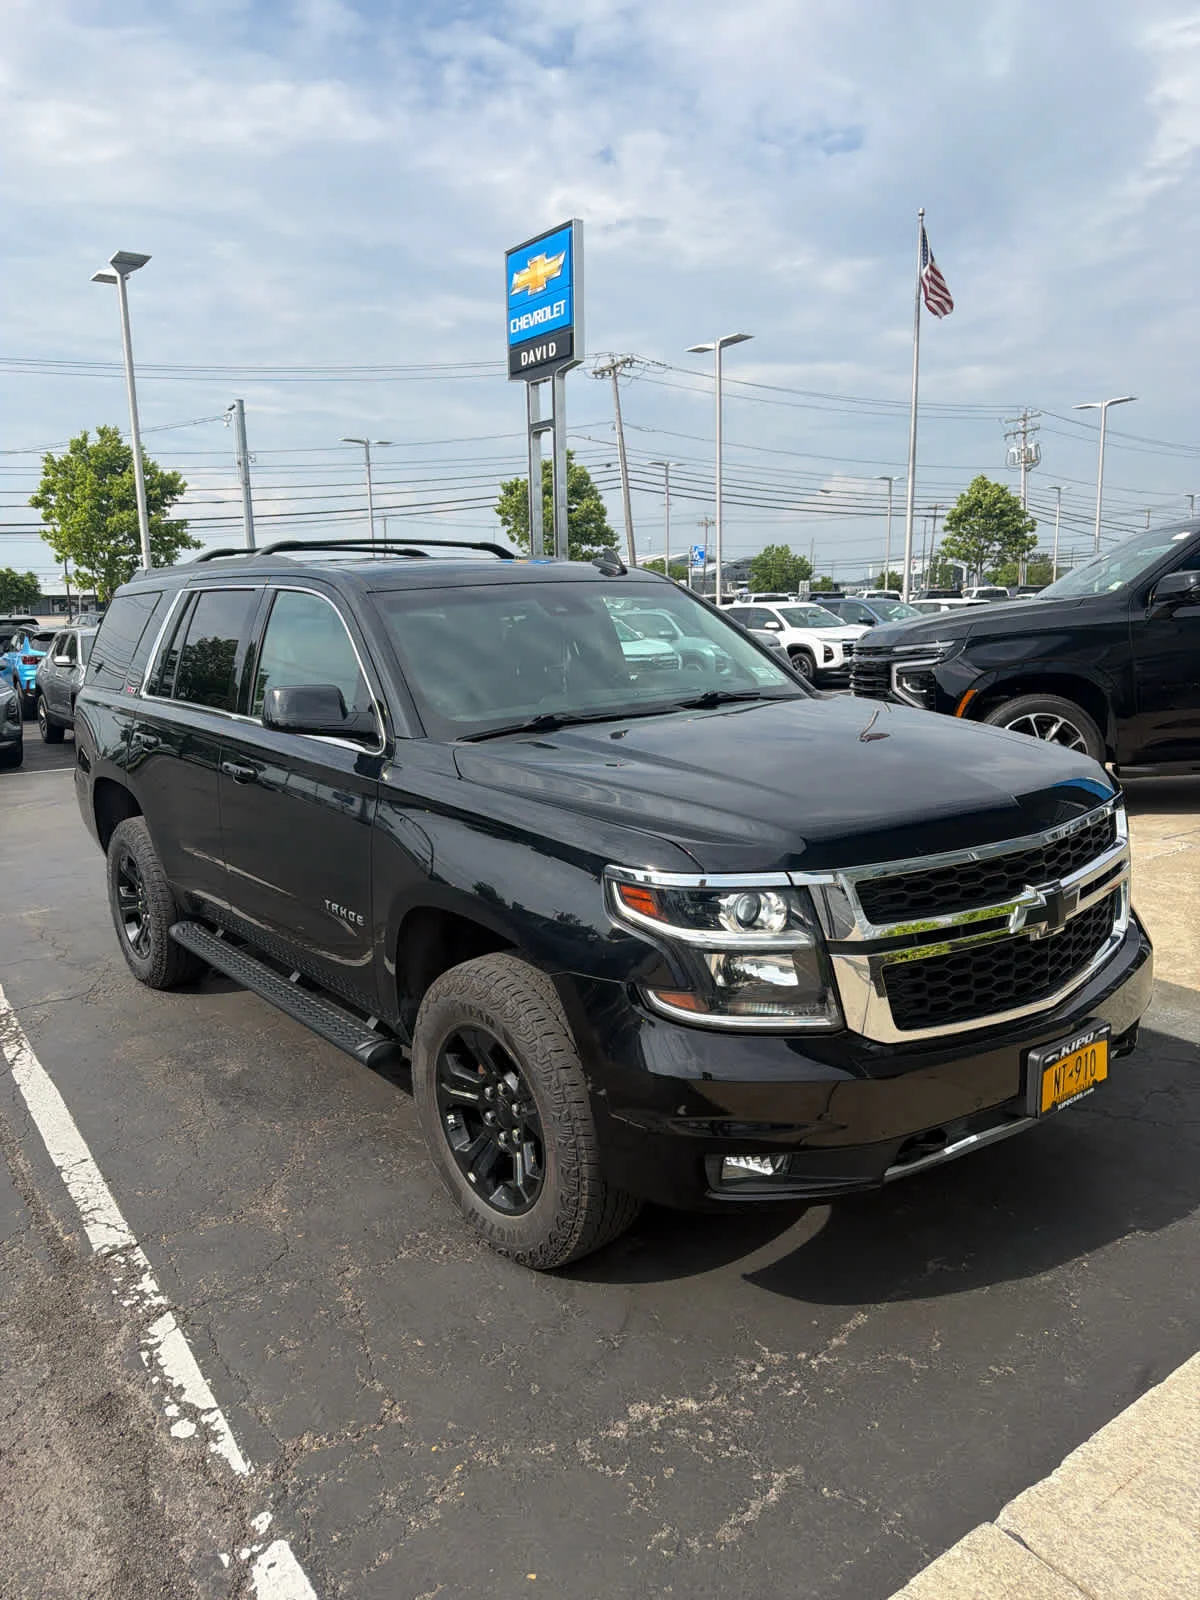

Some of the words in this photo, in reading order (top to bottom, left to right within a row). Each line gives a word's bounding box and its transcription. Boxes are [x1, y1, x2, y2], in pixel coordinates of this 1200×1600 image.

[510, 300, 566, 333] CHEVROLET
[521, 342, 556, 366] DAVID
[325, 900, 365, 926] TAHOE
